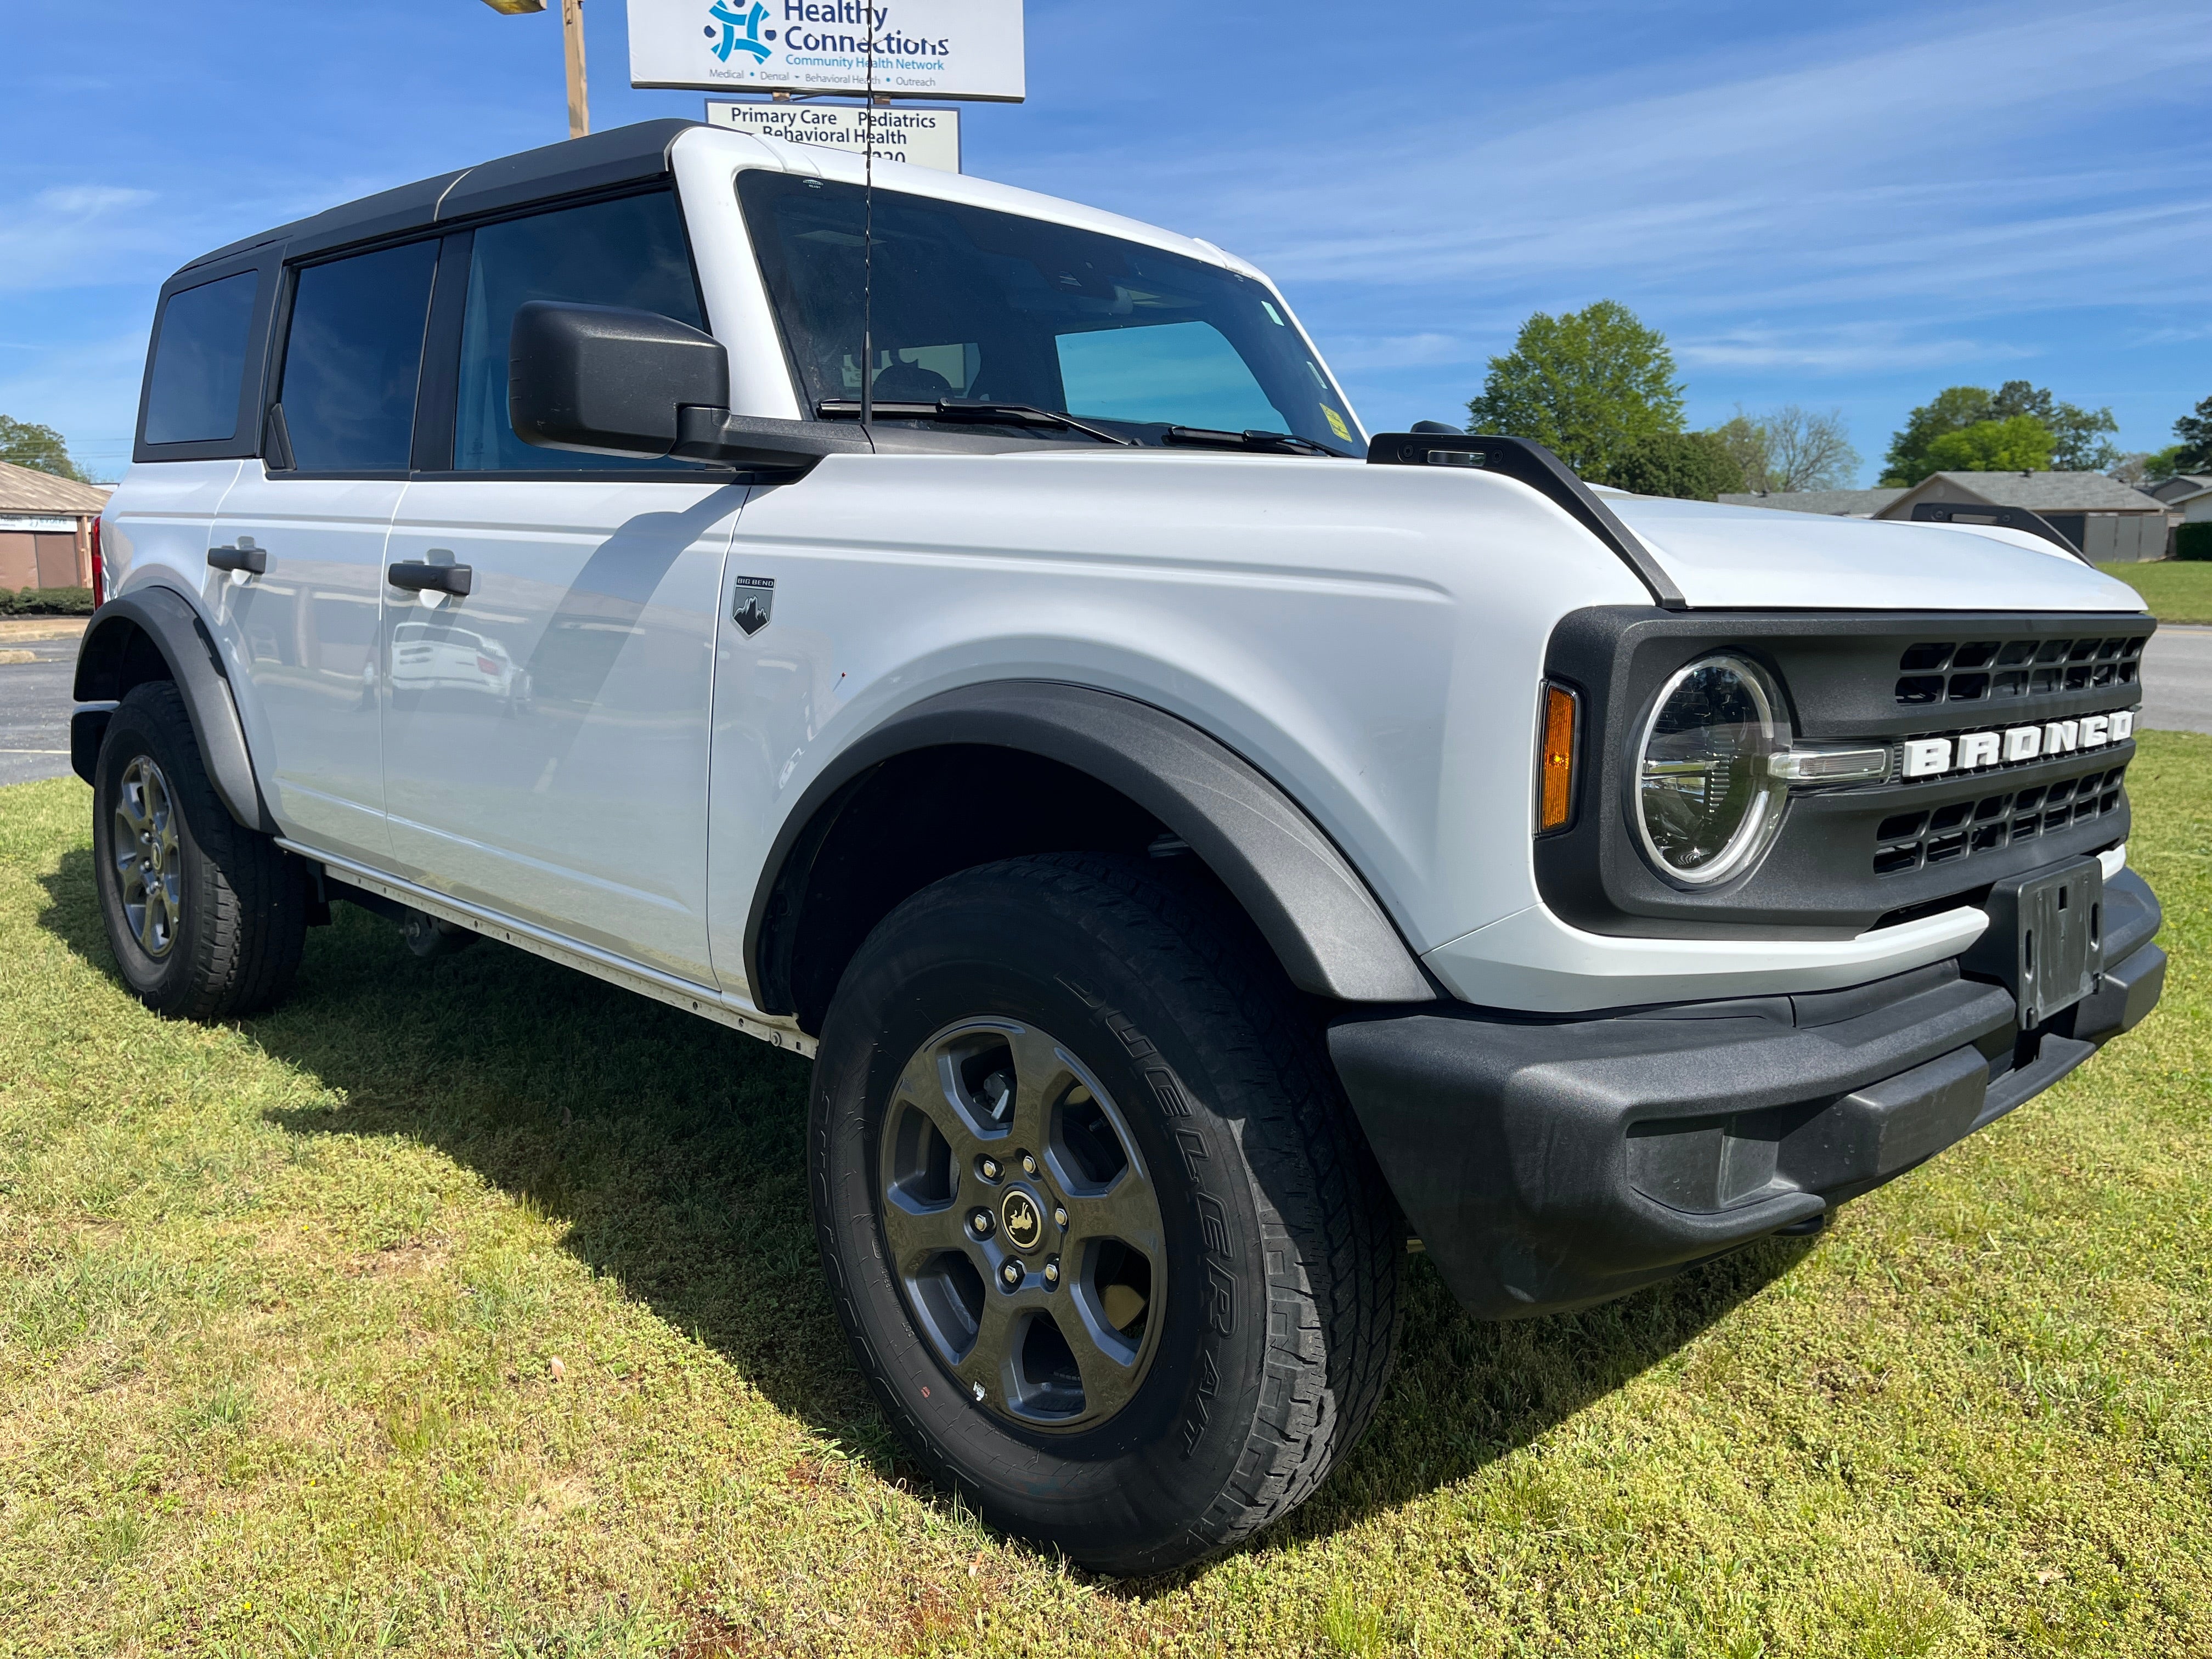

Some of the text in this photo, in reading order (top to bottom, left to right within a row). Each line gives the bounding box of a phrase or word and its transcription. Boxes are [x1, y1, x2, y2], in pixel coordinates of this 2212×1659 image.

[785, 0, 888, 31] Healthy
[785, 26, 949, 55] Connections
[786, 54, 945, 70] Community Health Network
[709, 69, 936, 86] Medical Dental Behavioral Heath Outreach
[731, 107, 936, 128] Primary Care Pediatrics
[763, 126, 907, 145] Behavioral Health
[1902, 710, 2134, 777] BRONCO
[1053, 964, 1239, 1338] DUELER
